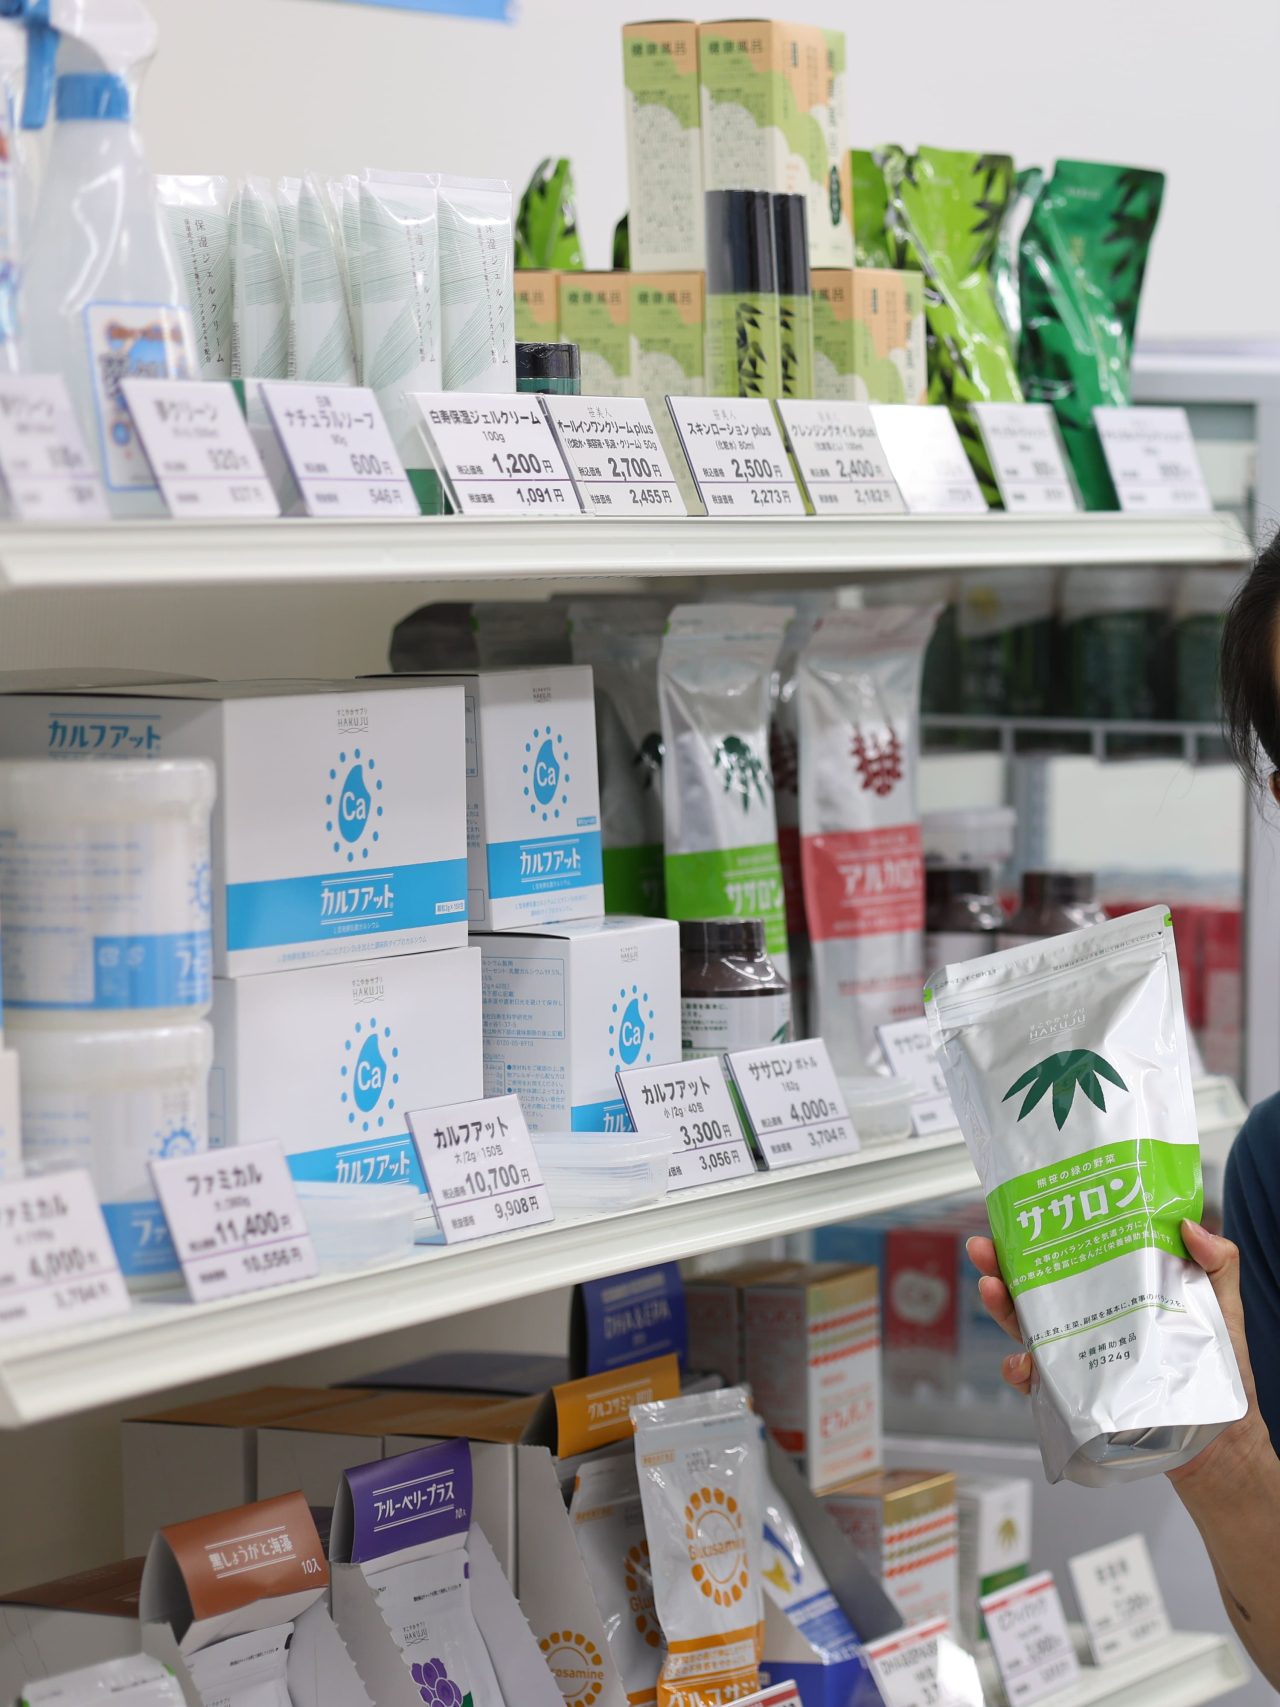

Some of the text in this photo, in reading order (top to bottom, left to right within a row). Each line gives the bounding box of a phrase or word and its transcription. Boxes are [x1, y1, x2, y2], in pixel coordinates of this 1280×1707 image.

[195, 219, 225, 363] 保湿ジェルクリーム
[284, 409, 374, 429] ナチュラルソープ
[429, 409, 542, 426] 白寿保湿ジェルクリーム
[687, 422, 772, 438] スキンローション plus
[482, 430, 506, 444] 100g
[492, 452, 554, 478] 1,200円
[607, 456, 662, 482] 2,700円
[730, 457, 783, 483] 2,500円
[516, 487, 565, 507] 1,091円
[629, 489, 673, 507] 2,455円
[750, 489, 791, 507] 2,273円
[47, 719, 160, 750] カルフアット
[337, 716, 369, 729] HAKUJU
[536, 761, 557, 787] Ca
[342, 791, 367, 822] Ca
[519, 847, 581, 875] カルフアット
[320, 883, 395, 916] カルフアット
[352, 985, 384, 999] HAKUJU
[622, 1021, 642, 1046] Ca
[1029, 1014, 1087, 1041] HAKUJU
[357, 1059, 383, 1090] Ca
[747, 1060, 794, 1082] ササロン
[641, 1075, 712, 1106] カルフアット
[789, 1098, 840, 1125] 4,000円
[433, 1115, 509, 1150] カルフアット
[679, 1119, 733, 1149] 3,300円
[807, 1128, 848, 1150] 3,704円
[335, 1150, 411, 1184] カルフアット
[698, 1149, 742, 1173] 3,056円
[1036, 1152, 1117, 1190] 熊笹の緑の野菜
[186, 1163, 263, 1196] ファミカル
[465, 1163, 532, 1196] 10,700円
[494, 1194, 540, 1222] 9,908円
[1016, 1177, 1143, 1242] ササロン
[1078, 1332, 1137, 1361] 栄養補助食品
[1087, 1350, 1131, 1371] 約324g
[373, 1481, 455, 1521] ブルーベリープラス
[208, 1534, 294, 1571] 黒しょうがと海藻
[301, 1557, 322, 1575] 10入
[404, 1628, 429, 1641] HAKUJU
